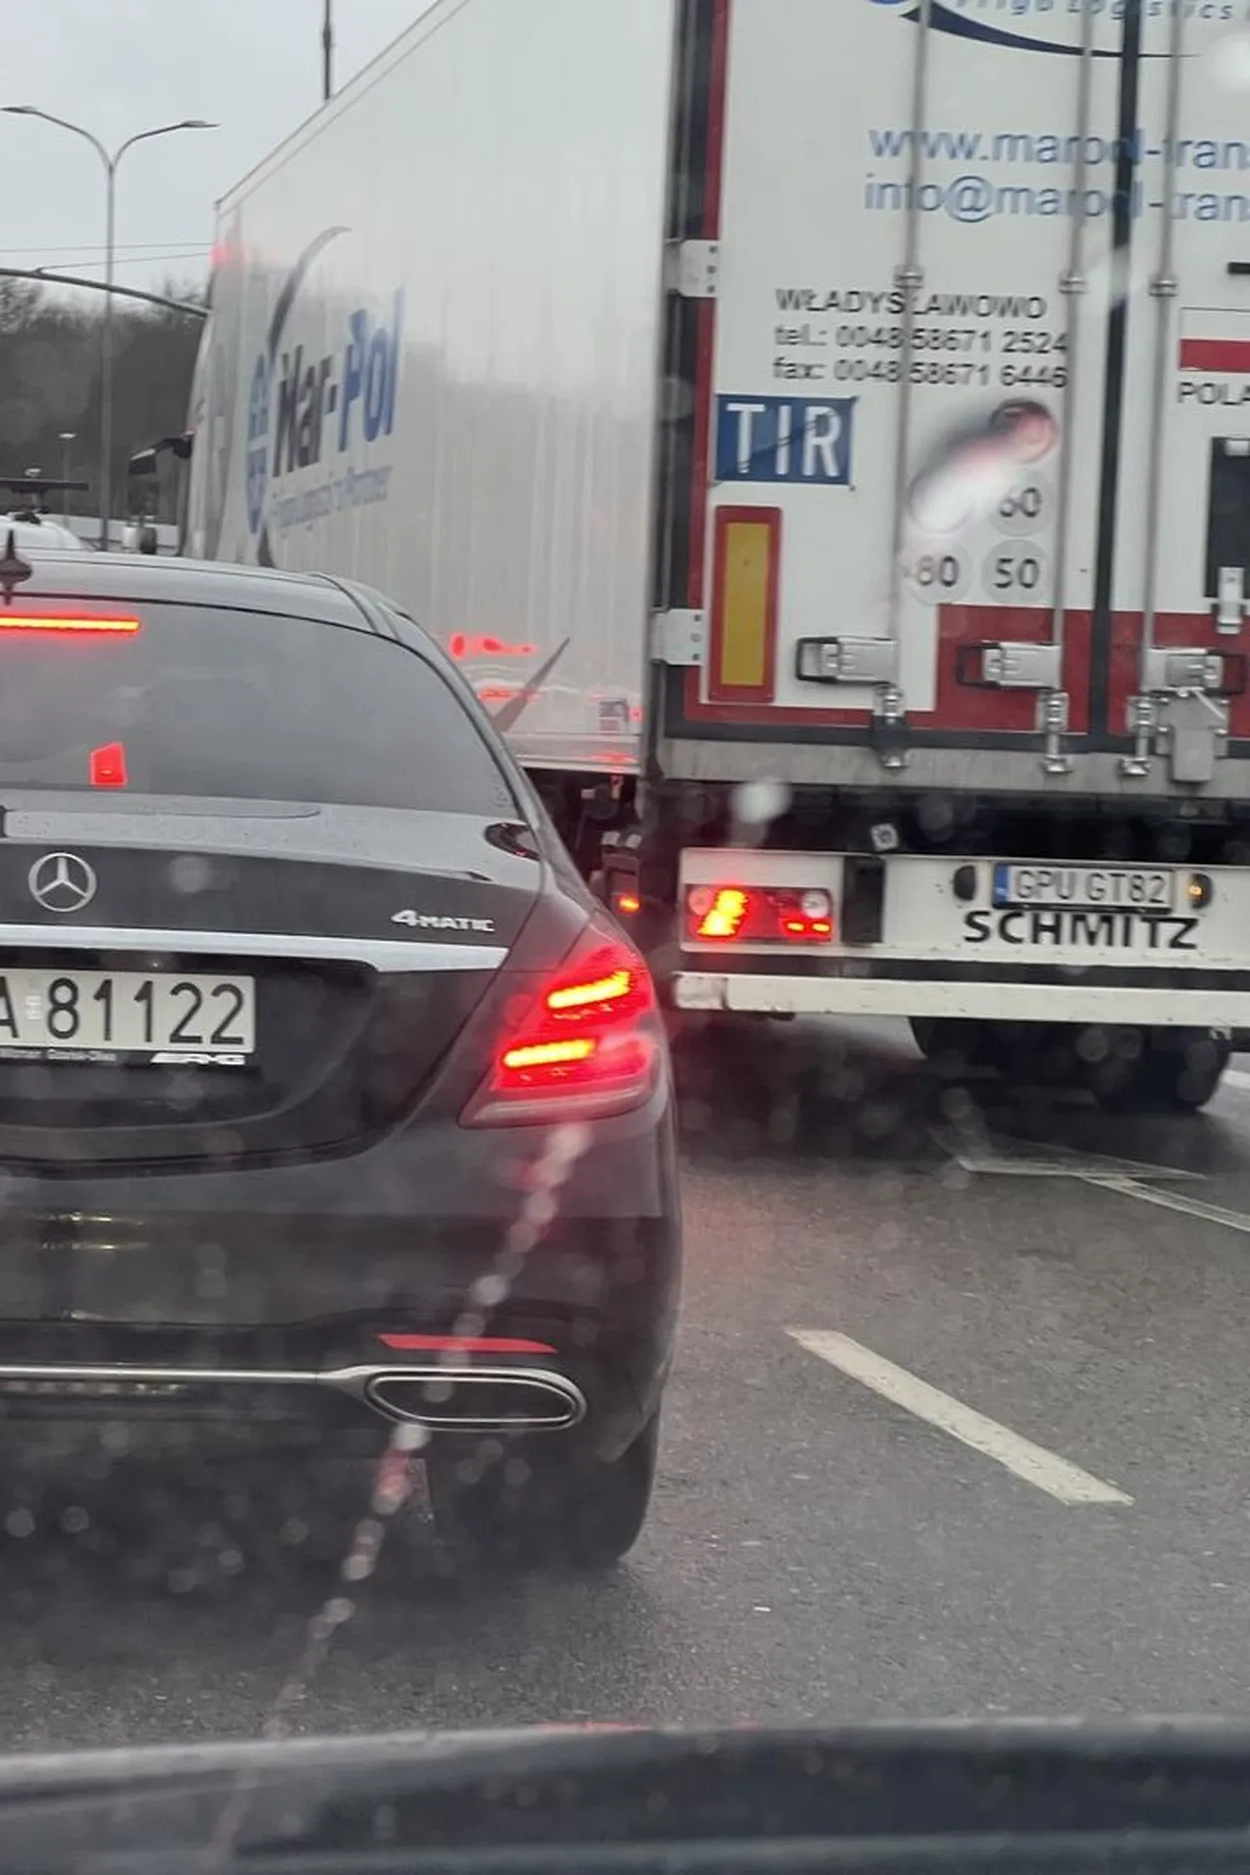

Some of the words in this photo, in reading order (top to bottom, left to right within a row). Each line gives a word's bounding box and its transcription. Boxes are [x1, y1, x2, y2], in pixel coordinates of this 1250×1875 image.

[835, 325, 904, 349] 0048
[910, 327, 992, 351] 58671
[1001, 330, 1068, 354] 2524
[833, 358, 901, 383] 0048
[908, 361, 990, 386] 58671
[1000, 364, 1067, 389] 6446
[724, 401, 845, 476] TIR
[993, 557, 1040, 589] 50
[1014, 870, 1077, 900] GPU
[1085, 872, 1166, 904] GT82
[963, 910, 1199, 950] SCHMITZ
[45, 977, 246, 1045] 81122
